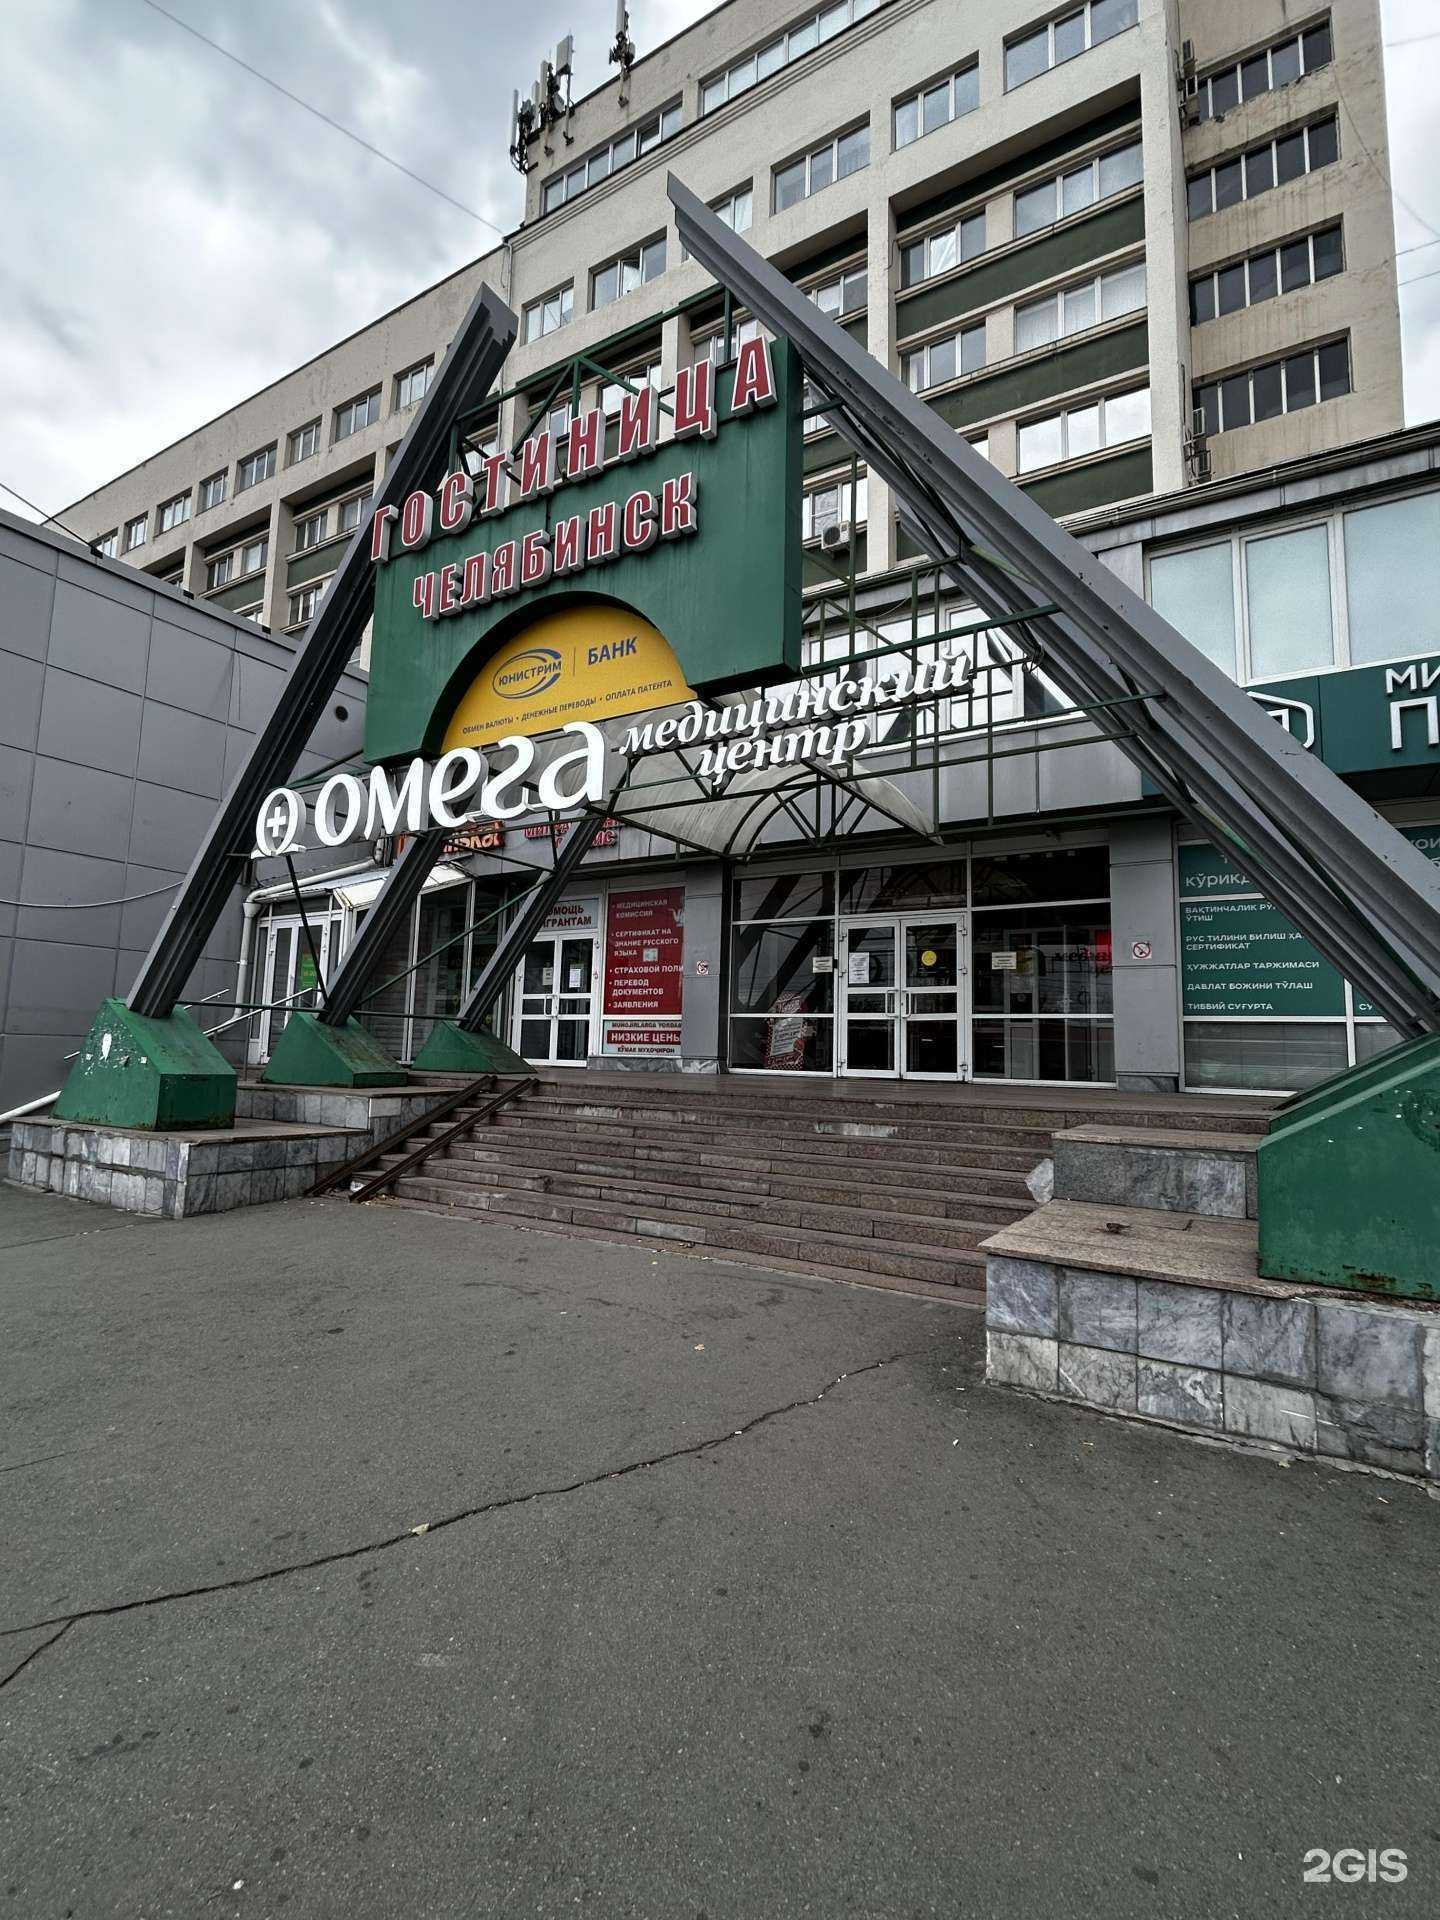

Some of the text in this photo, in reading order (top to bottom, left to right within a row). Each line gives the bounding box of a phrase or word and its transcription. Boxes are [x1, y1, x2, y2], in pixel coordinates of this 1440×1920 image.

[370, 334, 777, 563] ГОСТИНИЦА
[412, 471, 698, 622] ЧЕЛЯБИНСК
[587, 636, 638, 666] БАНК
[498, 659, 562, 687] ЮНИСТРИМ
[462, 678, 673, 734] ОБМЕН ВАЛЮТЫ ДЕНЕЖНЫЕ ПЕРЕВОДЫ ОПЛАТА ПАТЕНТА
[618, 648, 974, 757] медицинский
[699, 719, 868, 786] центр
[314, 721, 606, 848] омега
[615, 929, 661, 938] СЕРТИФИКАТ
[1185, 935, 1205, 943] РУС
[1206, 933, 1247, 942] ТИЛИНИ
[1248, 932, 1287, 941] БИЛИШ
[614, 937, 679, 948] ЗНАНИЕ РУССКОГО
[1185, 942, 1251, 951] СЕРТИФИКАТ
[614, 949, 638, 957] ЯЗЫКА
[614, 965, 660, 974] СТРАХОВОЙ
[1252, 961, 1320, 970] ТАРЖИМАСИ
[613, 979, 649, 987] ПЕРЕВОД
[1186, 980, 1313, 991] ДАВЛАТ БОЖИНИ ТЎЛАШ
[611, 987, 664, 997] ДОКУМЕНТОВ
[612, 1000, 659, 1009] ЗАЯВЛЕНИЯ
[611, 1032, 650, 1042] НИЗКИЕ
